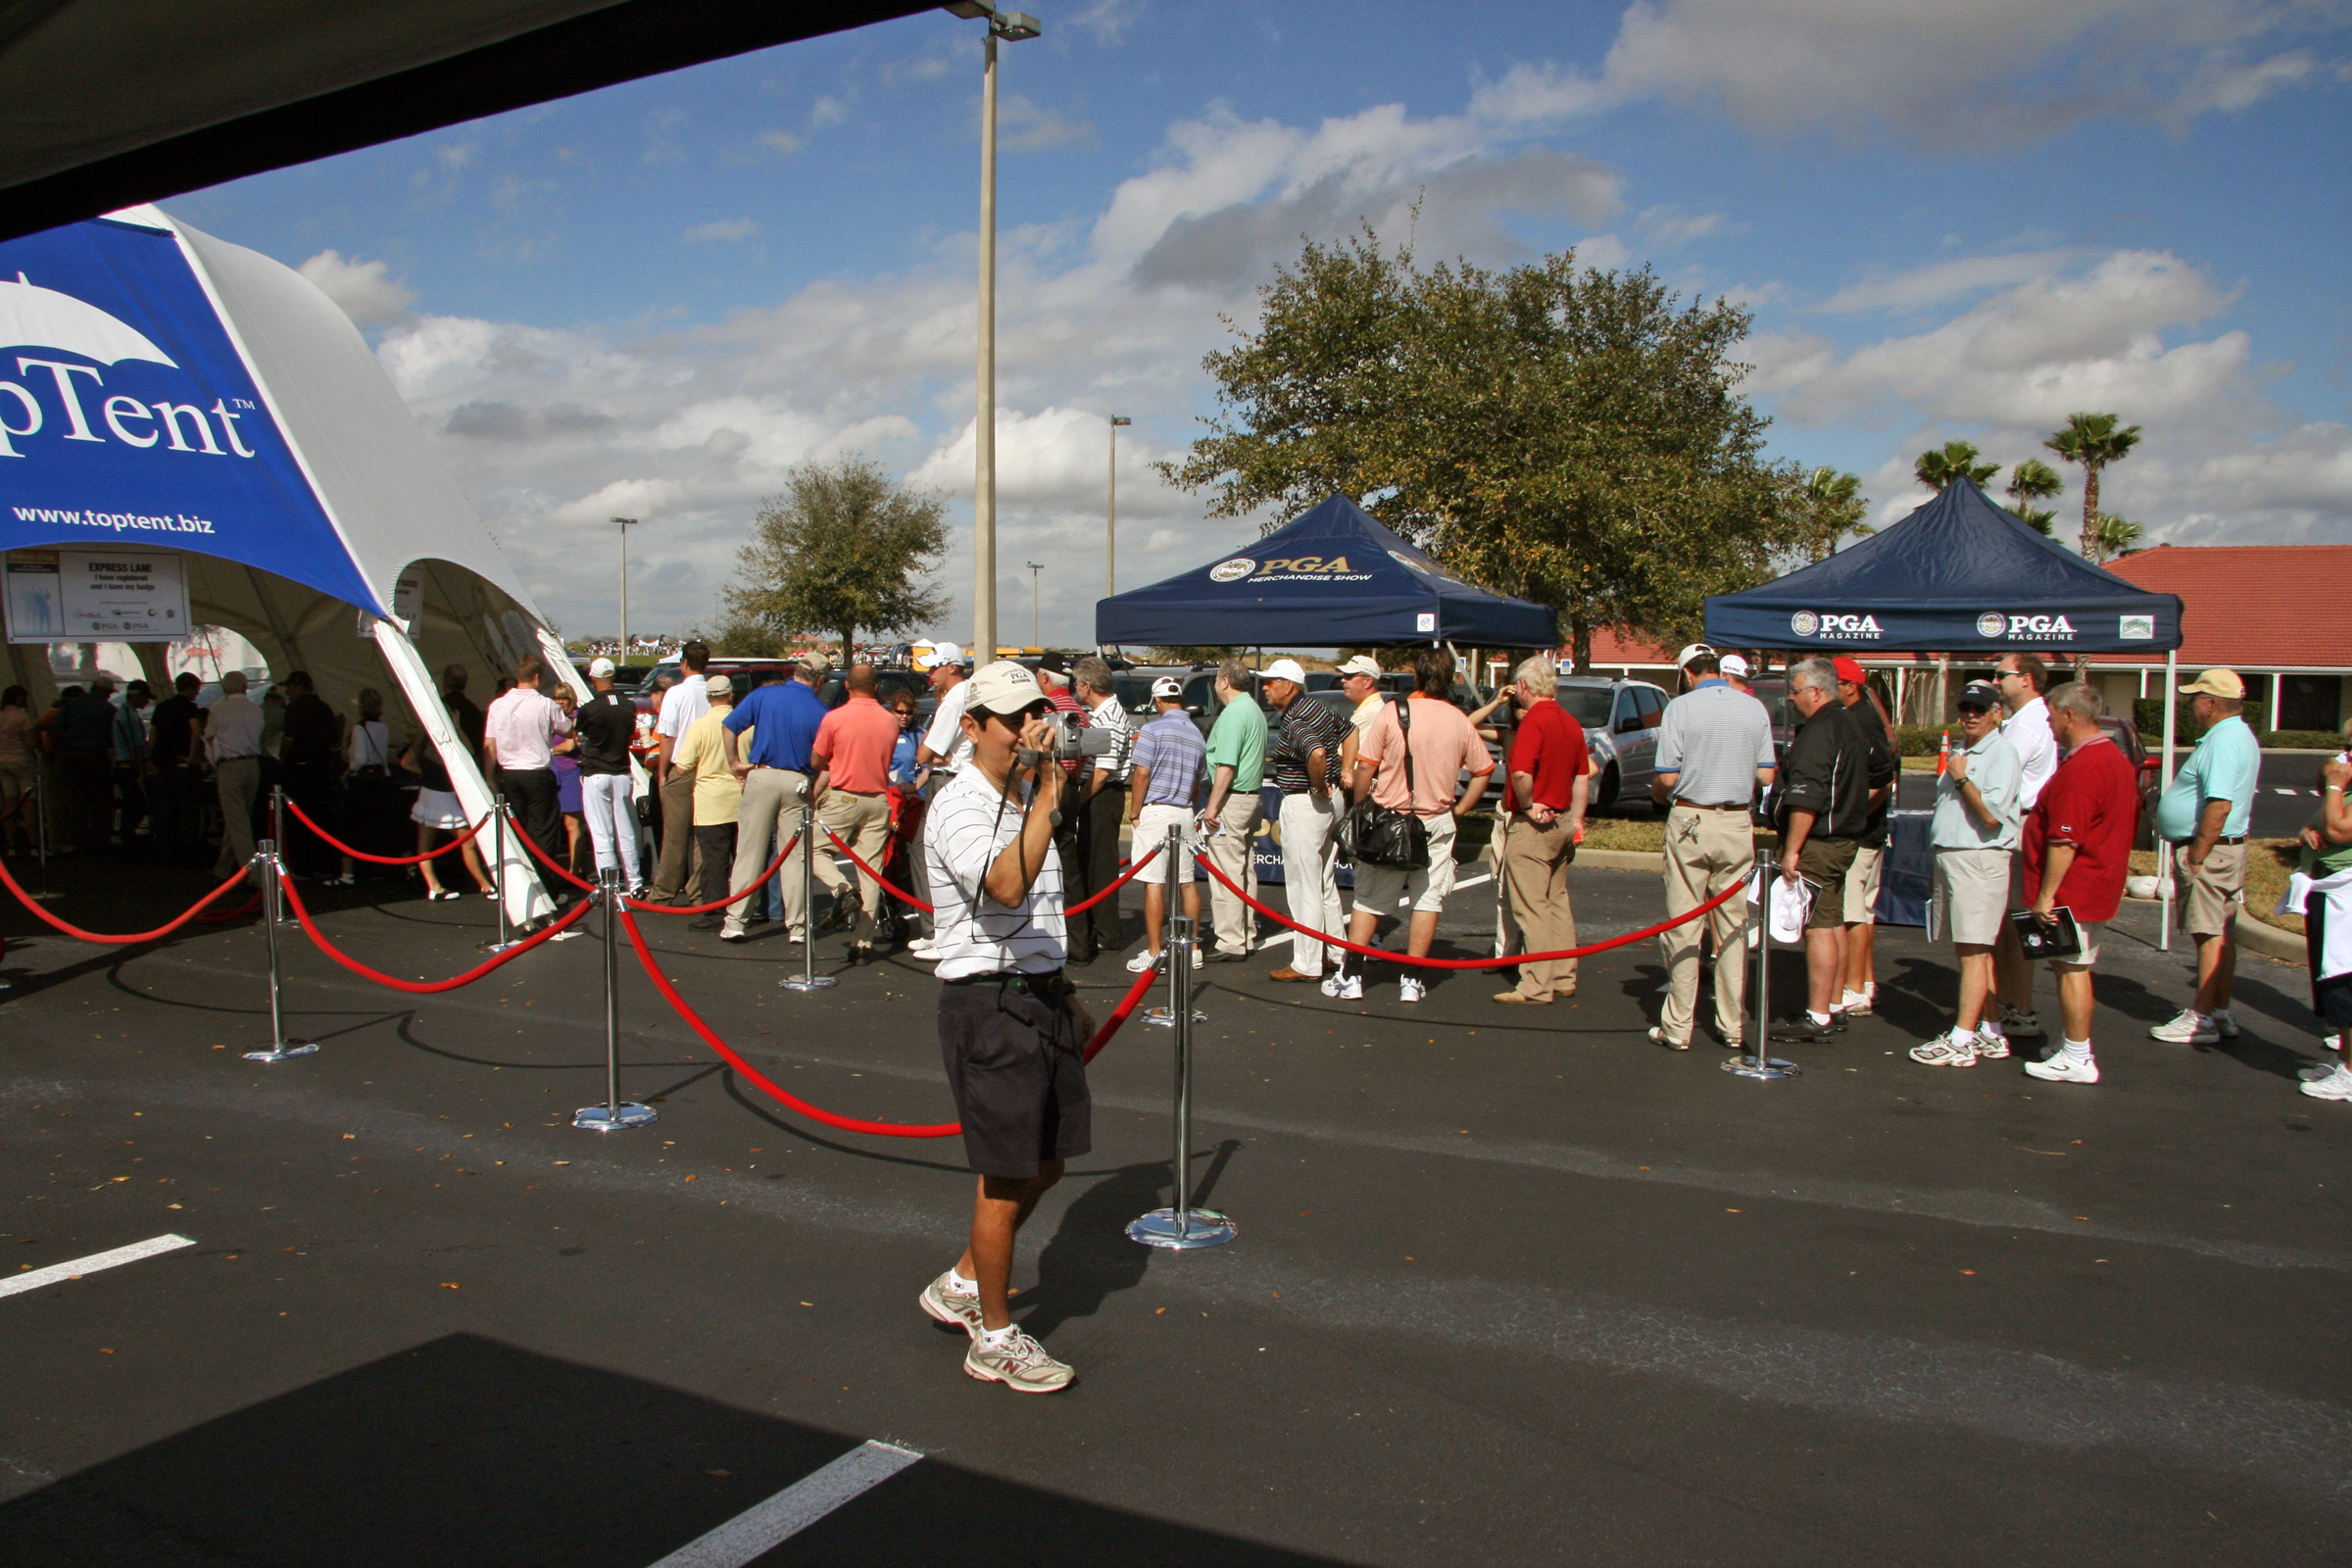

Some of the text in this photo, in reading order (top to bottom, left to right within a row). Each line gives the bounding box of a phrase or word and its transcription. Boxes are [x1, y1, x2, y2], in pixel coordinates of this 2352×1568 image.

[12, 507, 216, 534] www.toptent.biz
[89, 563, 152, 572] EXPRESS LANE
[1254, 556, 1351, 576] PGA
[1247, 574, 1332, 583] MERCHANDISE
[1820, 614, 1880, 632] PGA
[2009, 615, 2074, 633] PGA
